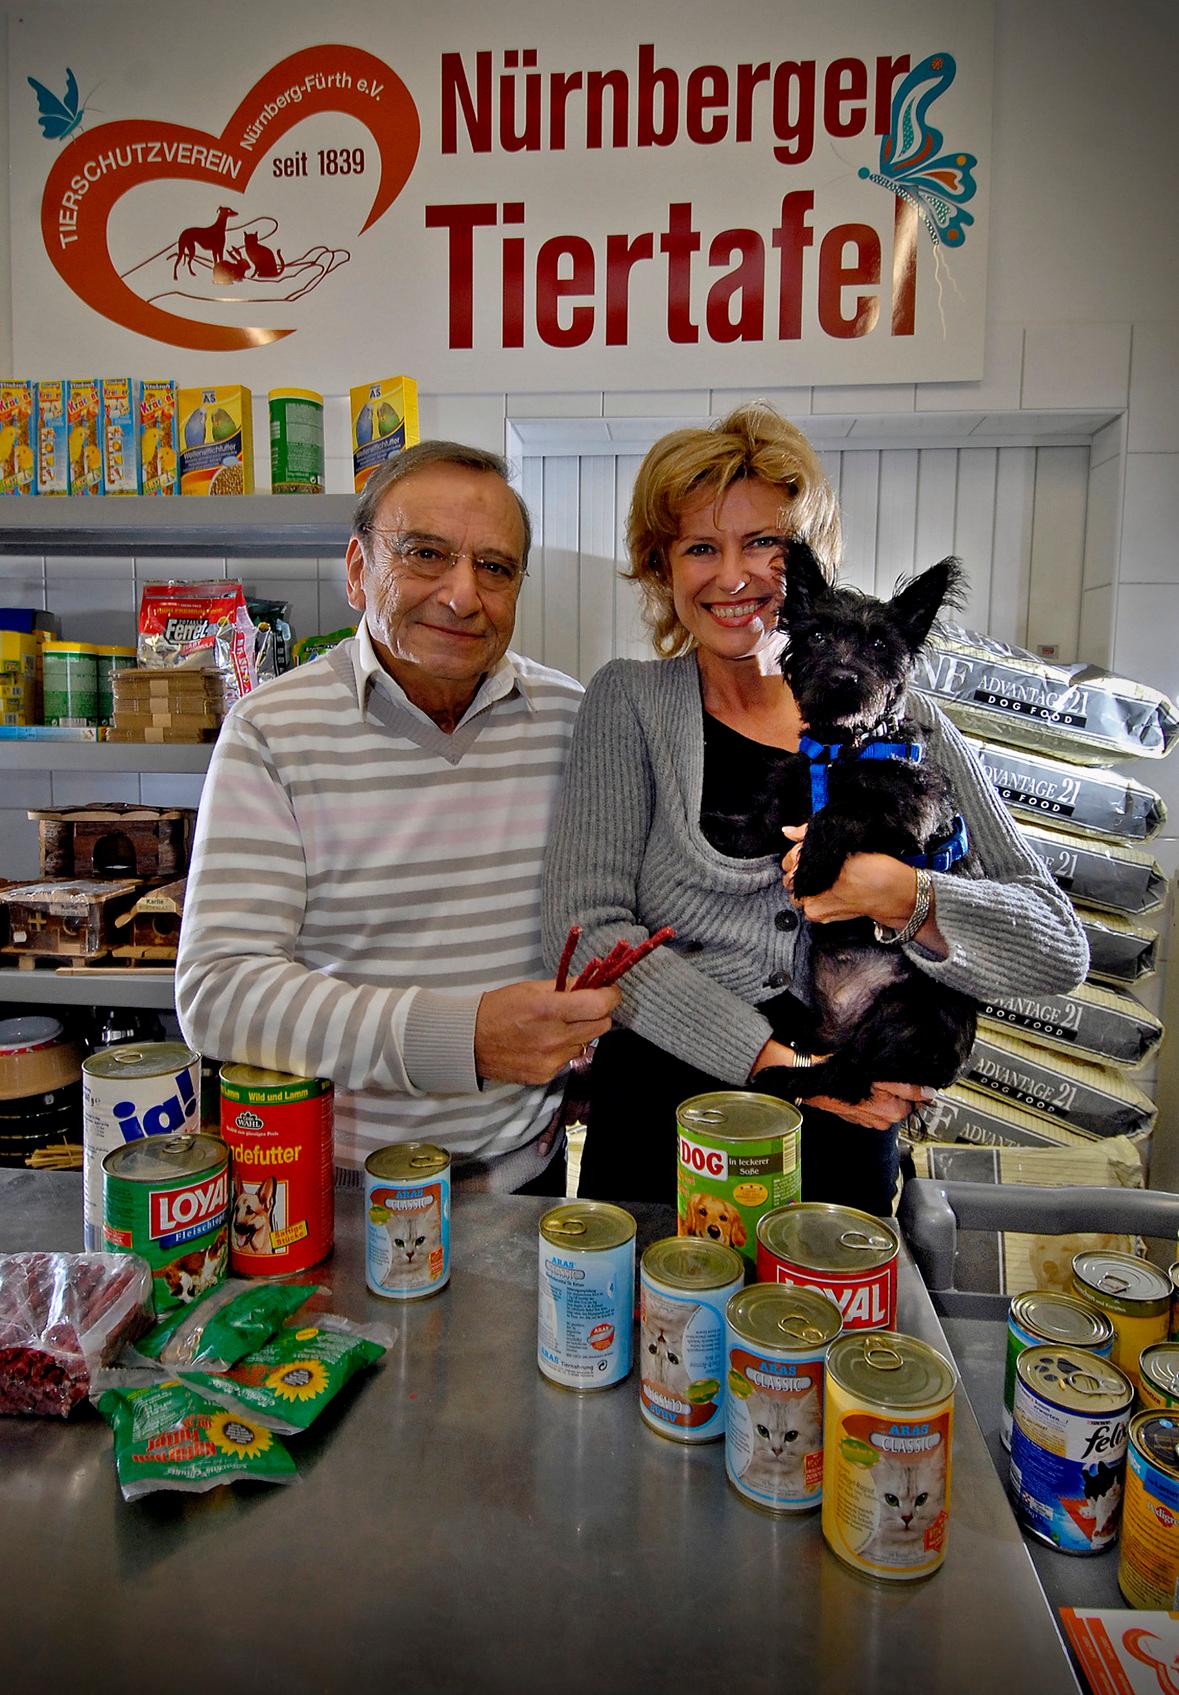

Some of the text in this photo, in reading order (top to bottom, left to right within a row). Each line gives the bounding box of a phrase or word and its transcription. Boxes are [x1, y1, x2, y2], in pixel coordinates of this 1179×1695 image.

[240, 72, 384, 151] Nürnberg-Fürth e.V.
[441, 43, 910, 165] Nürnberger
[272, 148, 365, 177] seit 1839
[57, 141, 243, 250] TIERSCHUTZVEREIN
[425, 190, 918, 349] Tiertafel
[166, 619, 208, 641] Ferret
[978, 675, 1089, 717] ADVANTAG 21
[988, 695, 1073, 724] DOG FOOD
[1019, 795, 1060, 812] FOOD
[1057, 777, 1081, 806] 21
[1055, 851, 1079, 878] 21
[986, 1006, 1063, 1036] DOG FOOD
[1061, 1003, 1083, 1030] 21
[249, 1089, 308, 1102] Wild und Lamm
[973, 1058, 1077, 1110] ADVANTAGE 21
[980, 1078, 1055, 1112] DOG FOOD
[238, 1119, 260, 1128] WAHL
[681, 1139, 724, 1176] DOG
[729, 1157, 769, 1167] in leckerer
[740, 1168, 759, 1177] Soße
[391, 1200, 425, 1211] CLASSIC
[552, 1257, 575, 1269] ARAS
[785, 1277, 886, 1324] YAL
[760, 1362, 796, 1375] ARAS
[753, 1373, 802, 1392] CLASSIC
[889, 1424, 929, 1435] ARAS
[881, 1436, 932, 1454] CLASSIC
